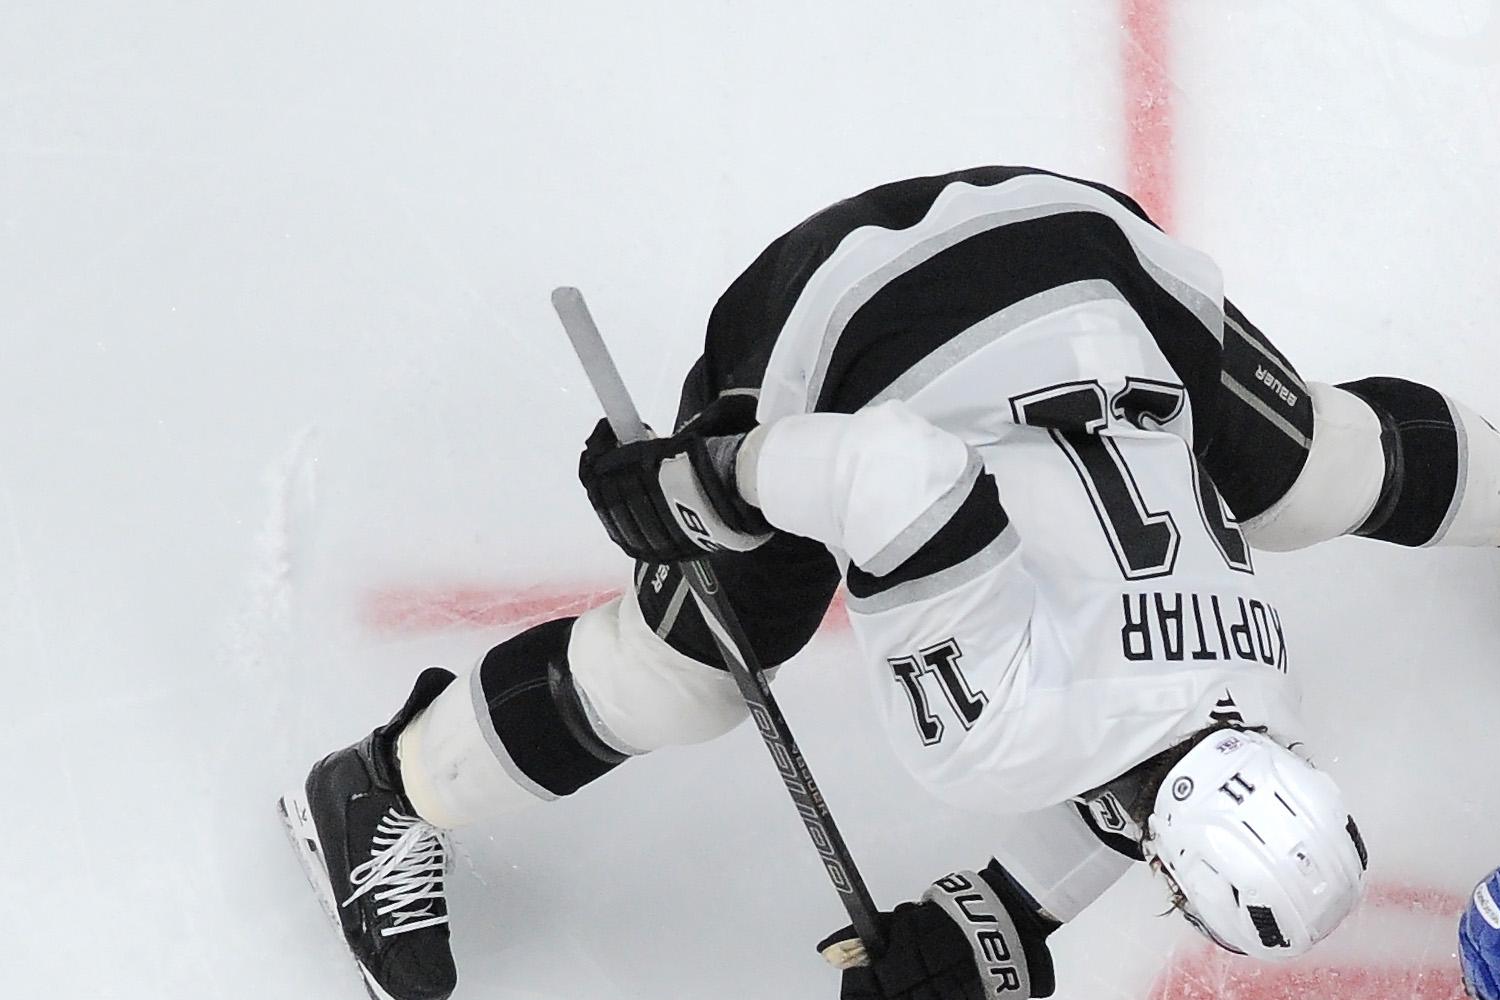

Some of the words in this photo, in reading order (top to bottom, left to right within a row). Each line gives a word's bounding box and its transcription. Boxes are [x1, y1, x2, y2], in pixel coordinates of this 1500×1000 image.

[1256, 364, 1297, 408] BAUER
[1121, 592, 1288, 675] KOPITAR
[887, 637, 990, 747] 11
[1218, 772, 1255, 805] 11
[933, 873, 1021, 995] AUER
